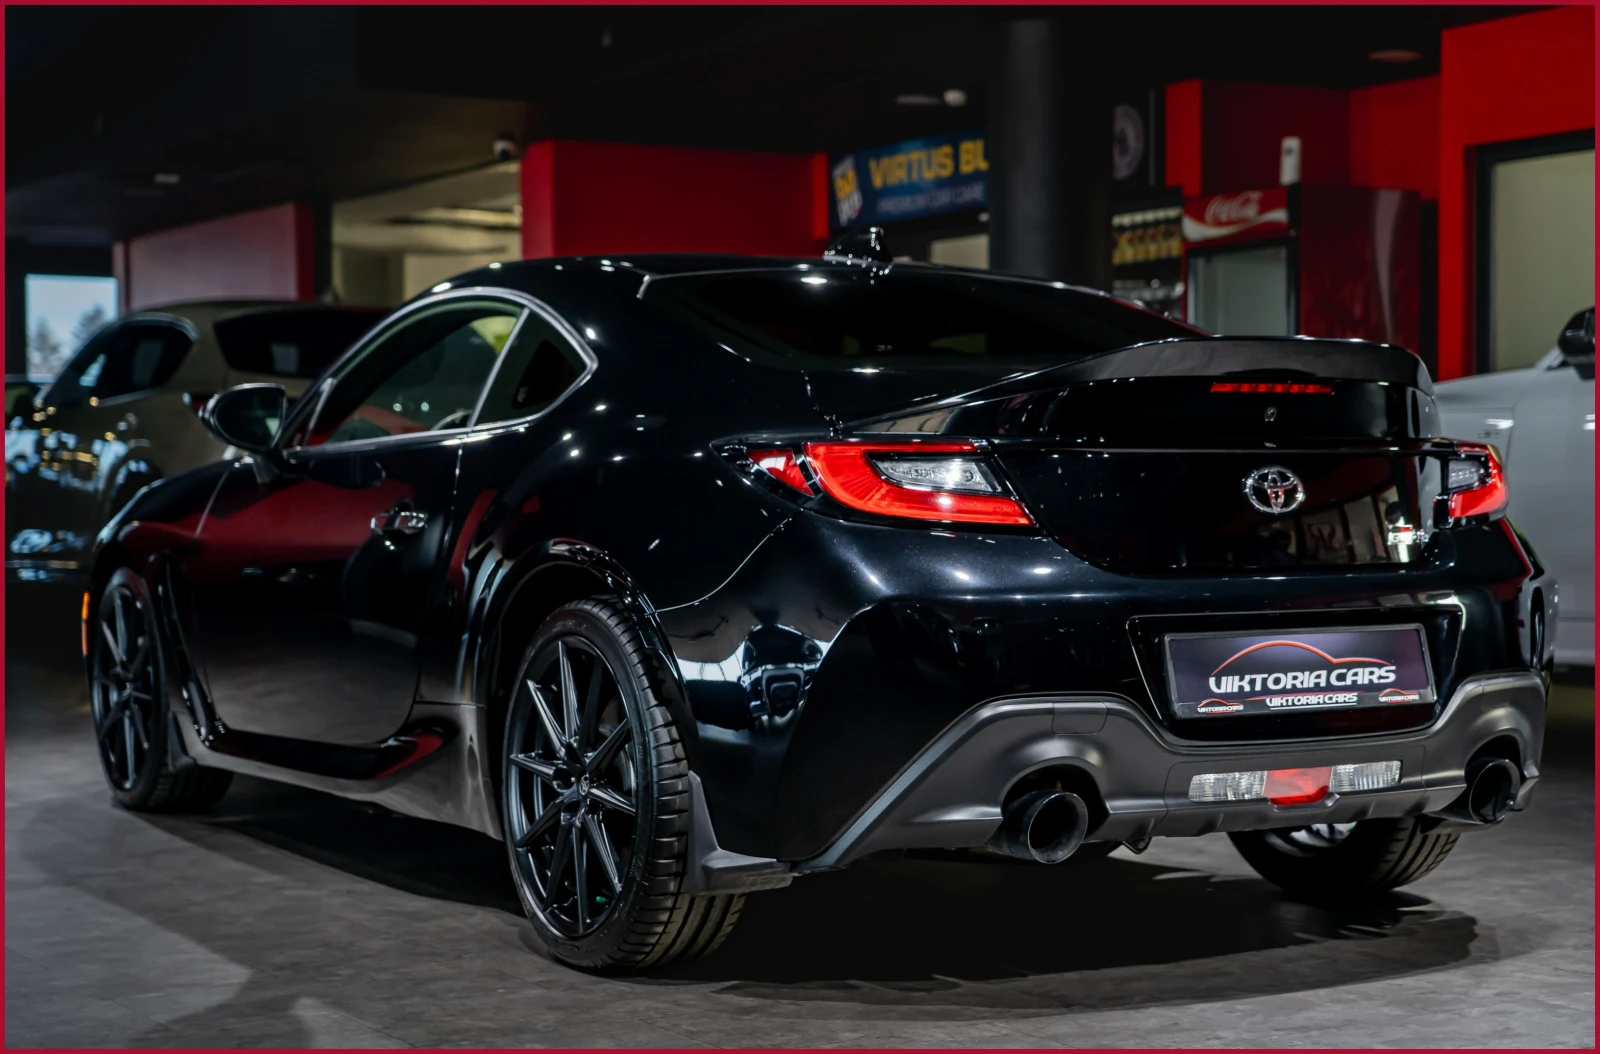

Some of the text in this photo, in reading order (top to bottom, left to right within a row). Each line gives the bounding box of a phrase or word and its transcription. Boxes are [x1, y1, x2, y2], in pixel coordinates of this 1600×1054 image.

[869, 144, 954, 189] VIRTUS
[1209, 665, 1397, 694] VIKTORIA CARS
[1266, 693, 1358, 707] VIKTORIA CARS
